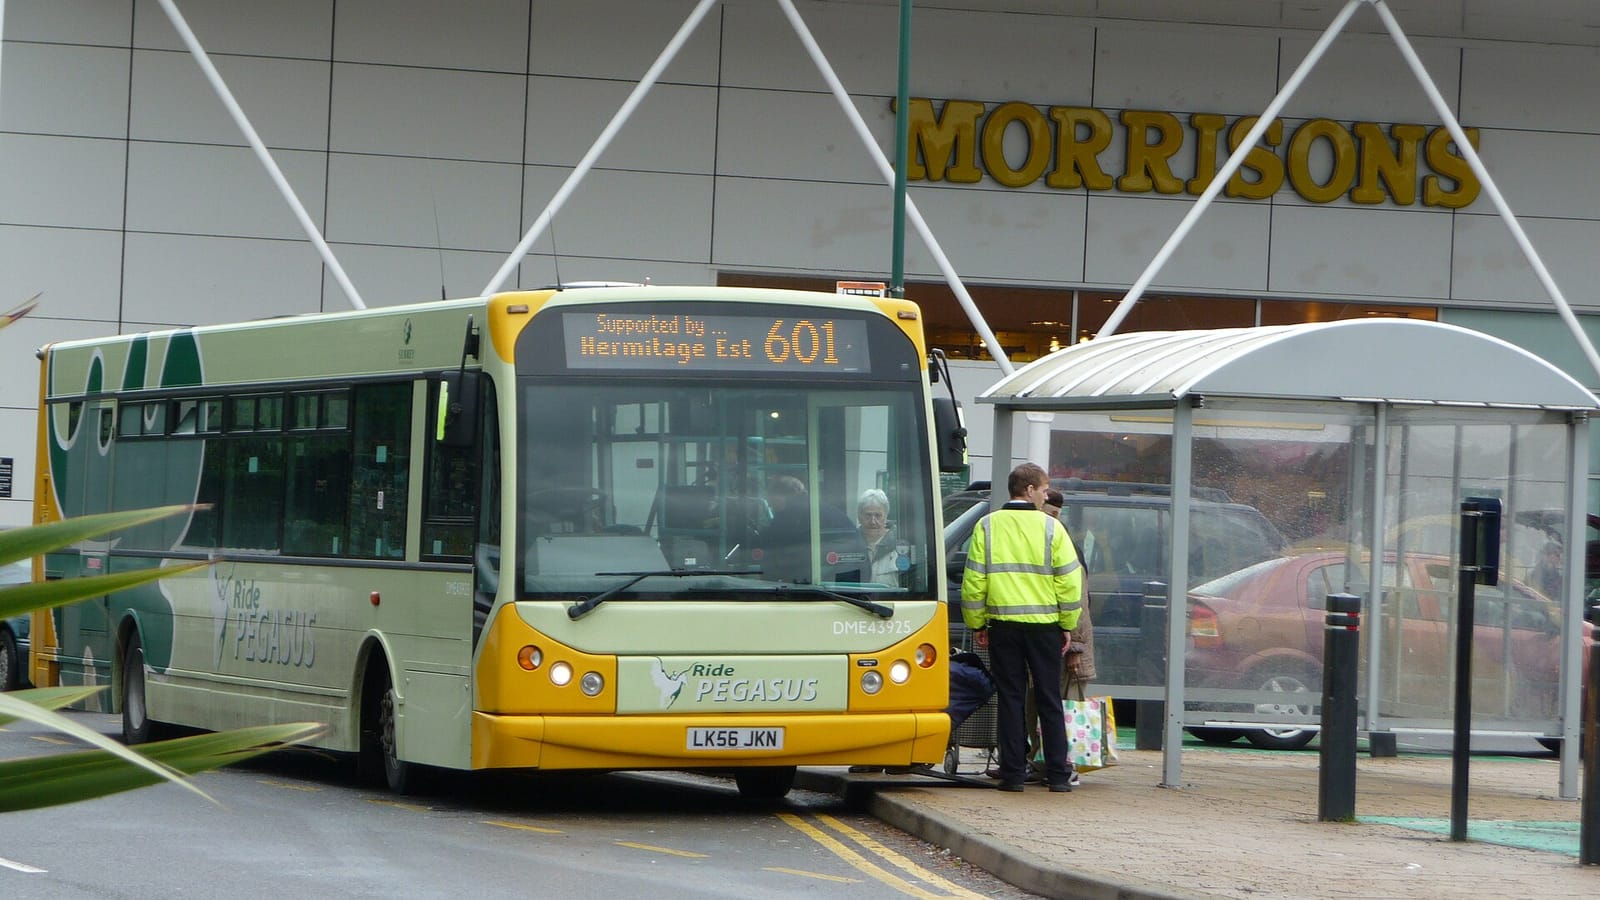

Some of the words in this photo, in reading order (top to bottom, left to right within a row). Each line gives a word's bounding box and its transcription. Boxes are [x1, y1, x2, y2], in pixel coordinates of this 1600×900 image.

[892, 97, 1481, 209] MORRISONS
[596, 313, 679, 335] Supported
[685, 315, 705, 337] by
[580, 336, 706, 364] Hermitage
[716, 339, 752, 358] Est
[764, 320, 839, 364] 601
[233, 579, 261, 610] Ride
[235, 607, 318, 669] PEGASUS
[832, 620, 912, 635] DME43925
[692, 664, 735, 677] Ride
[696, 678, 819, 703] PEGASUS
[693, 730, 738, 747] LK56
[743, 730, 777, 748] JKN
